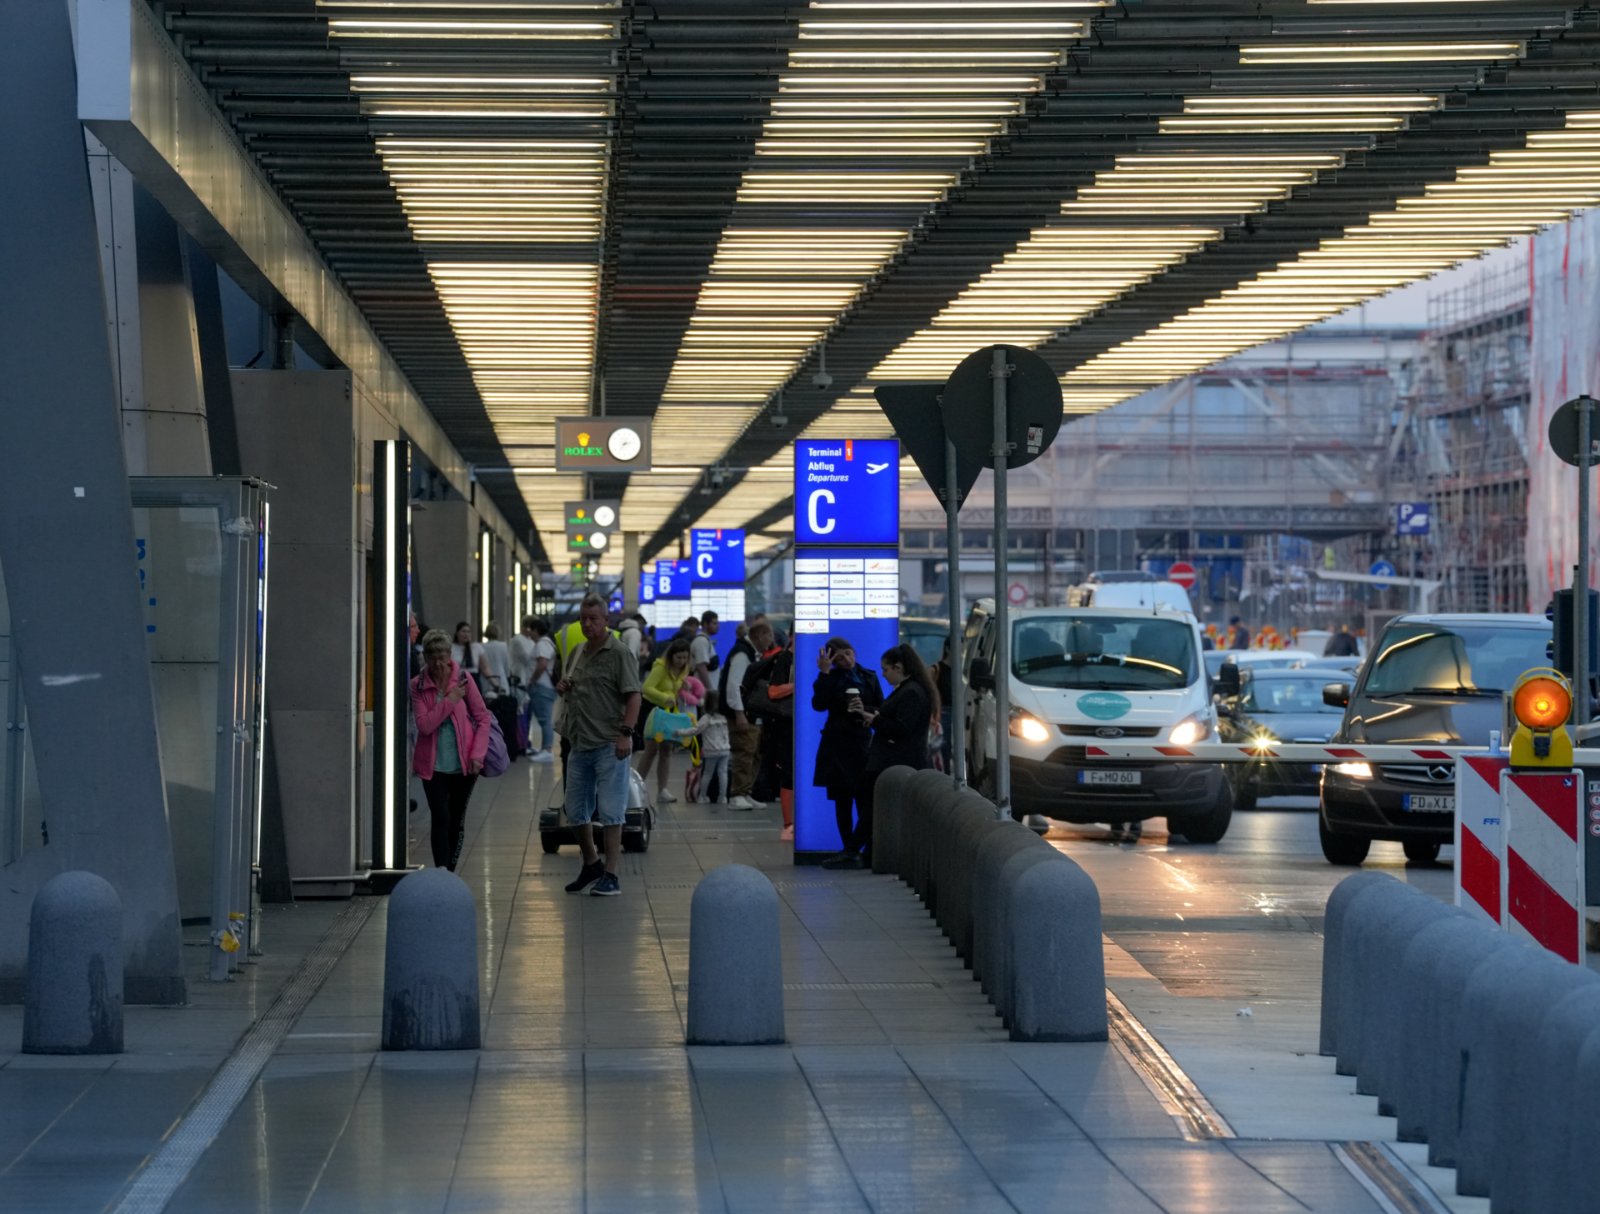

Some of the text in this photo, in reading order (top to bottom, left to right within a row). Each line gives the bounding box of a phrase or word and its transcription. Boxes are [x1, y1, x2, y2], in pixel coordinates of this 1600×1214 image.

[564, 447, 603, 456] ROLEX
[808, 447, 842, 456] Terminal
[808, 462, 834, 472] Abflug
[808, 473, 849, 483] Departures
[808, 489, 836, 535] C
[1401, 504, 1413, 520] P
[697, 553, 713, 578] C
[659, 576, 671, 594] B
[643, 585, 654, 600] B
[1411, 796, 1425, 808] FD
